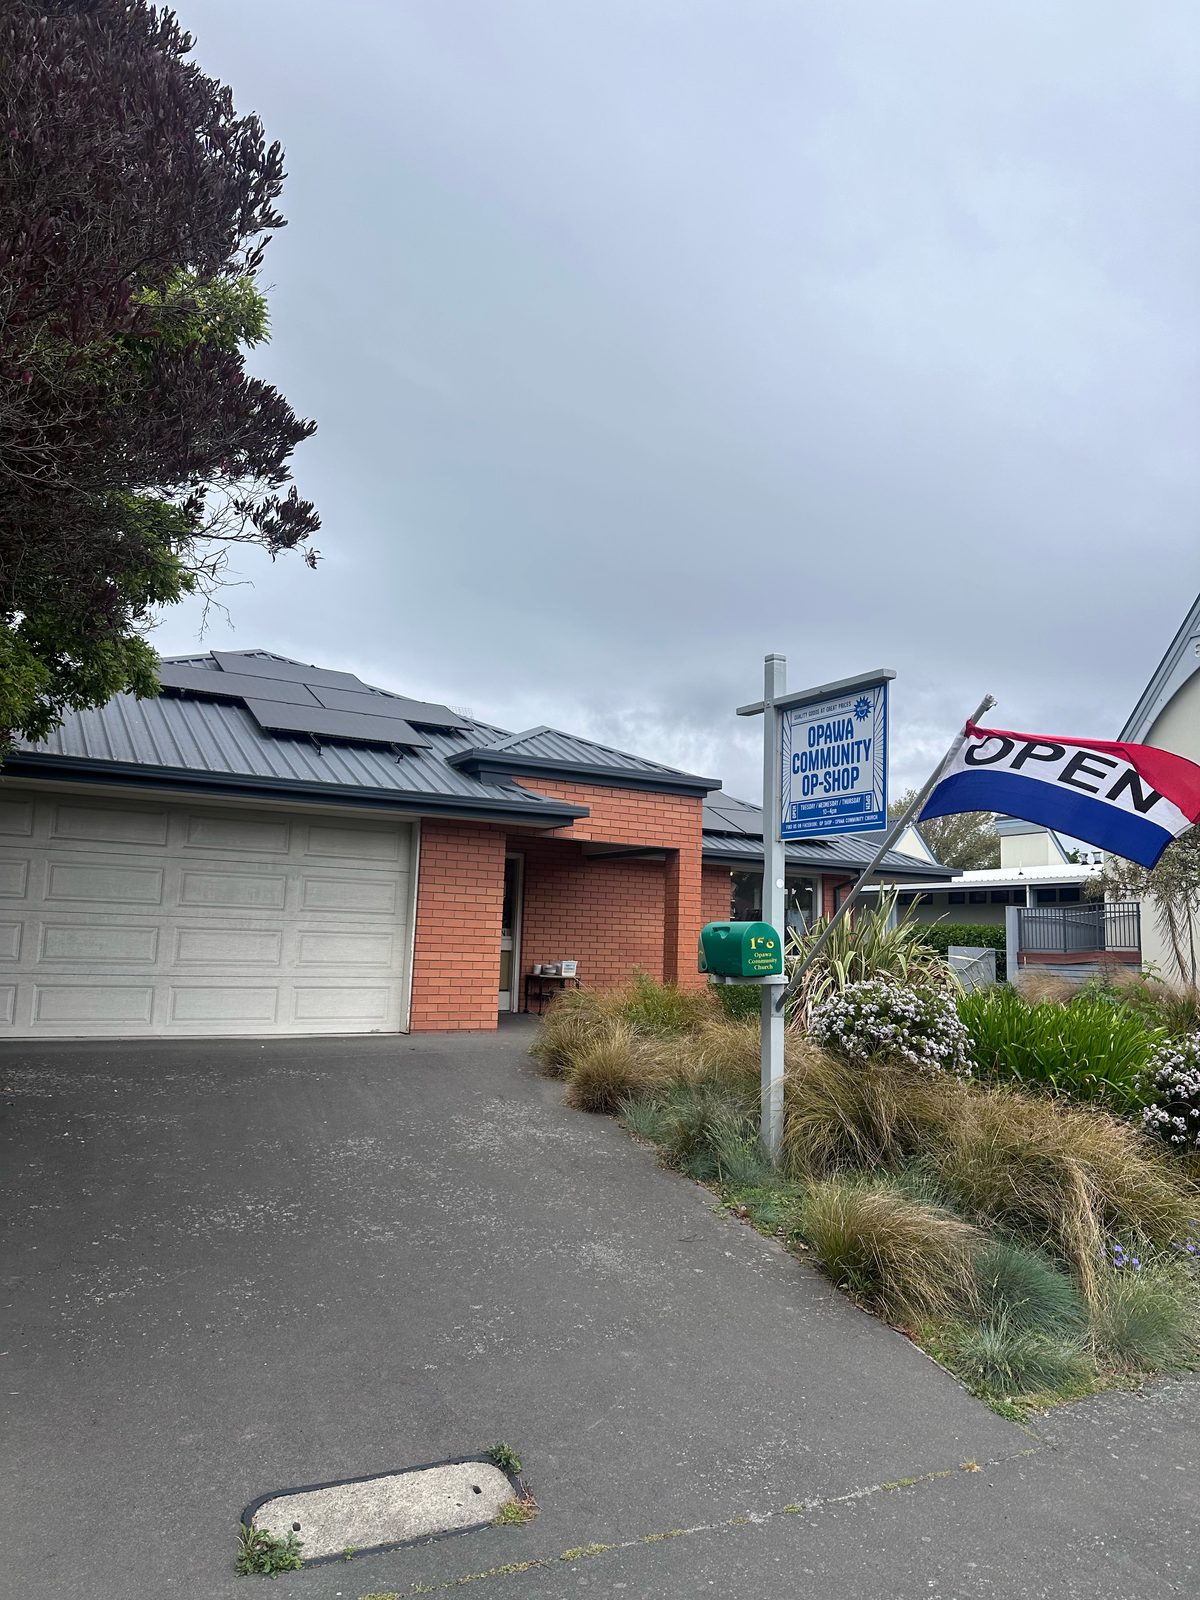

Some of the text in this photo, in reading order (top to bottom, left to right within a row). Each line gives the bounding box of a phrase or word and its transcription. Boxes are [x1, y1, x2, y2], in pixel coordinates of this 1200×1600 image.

[838, 701, 852, 709] PRICES
[808, 718, 854, 748] OPAWA
[792, 738, 872, 774] COMMUNITY
[802, 766, 860, 796] OP-SHOP
[964, 736, 1164, 814] OPEN
[800, 802, 815, 810] TUESDAY
[818, 799, 838, 808] WEDNESDAY
